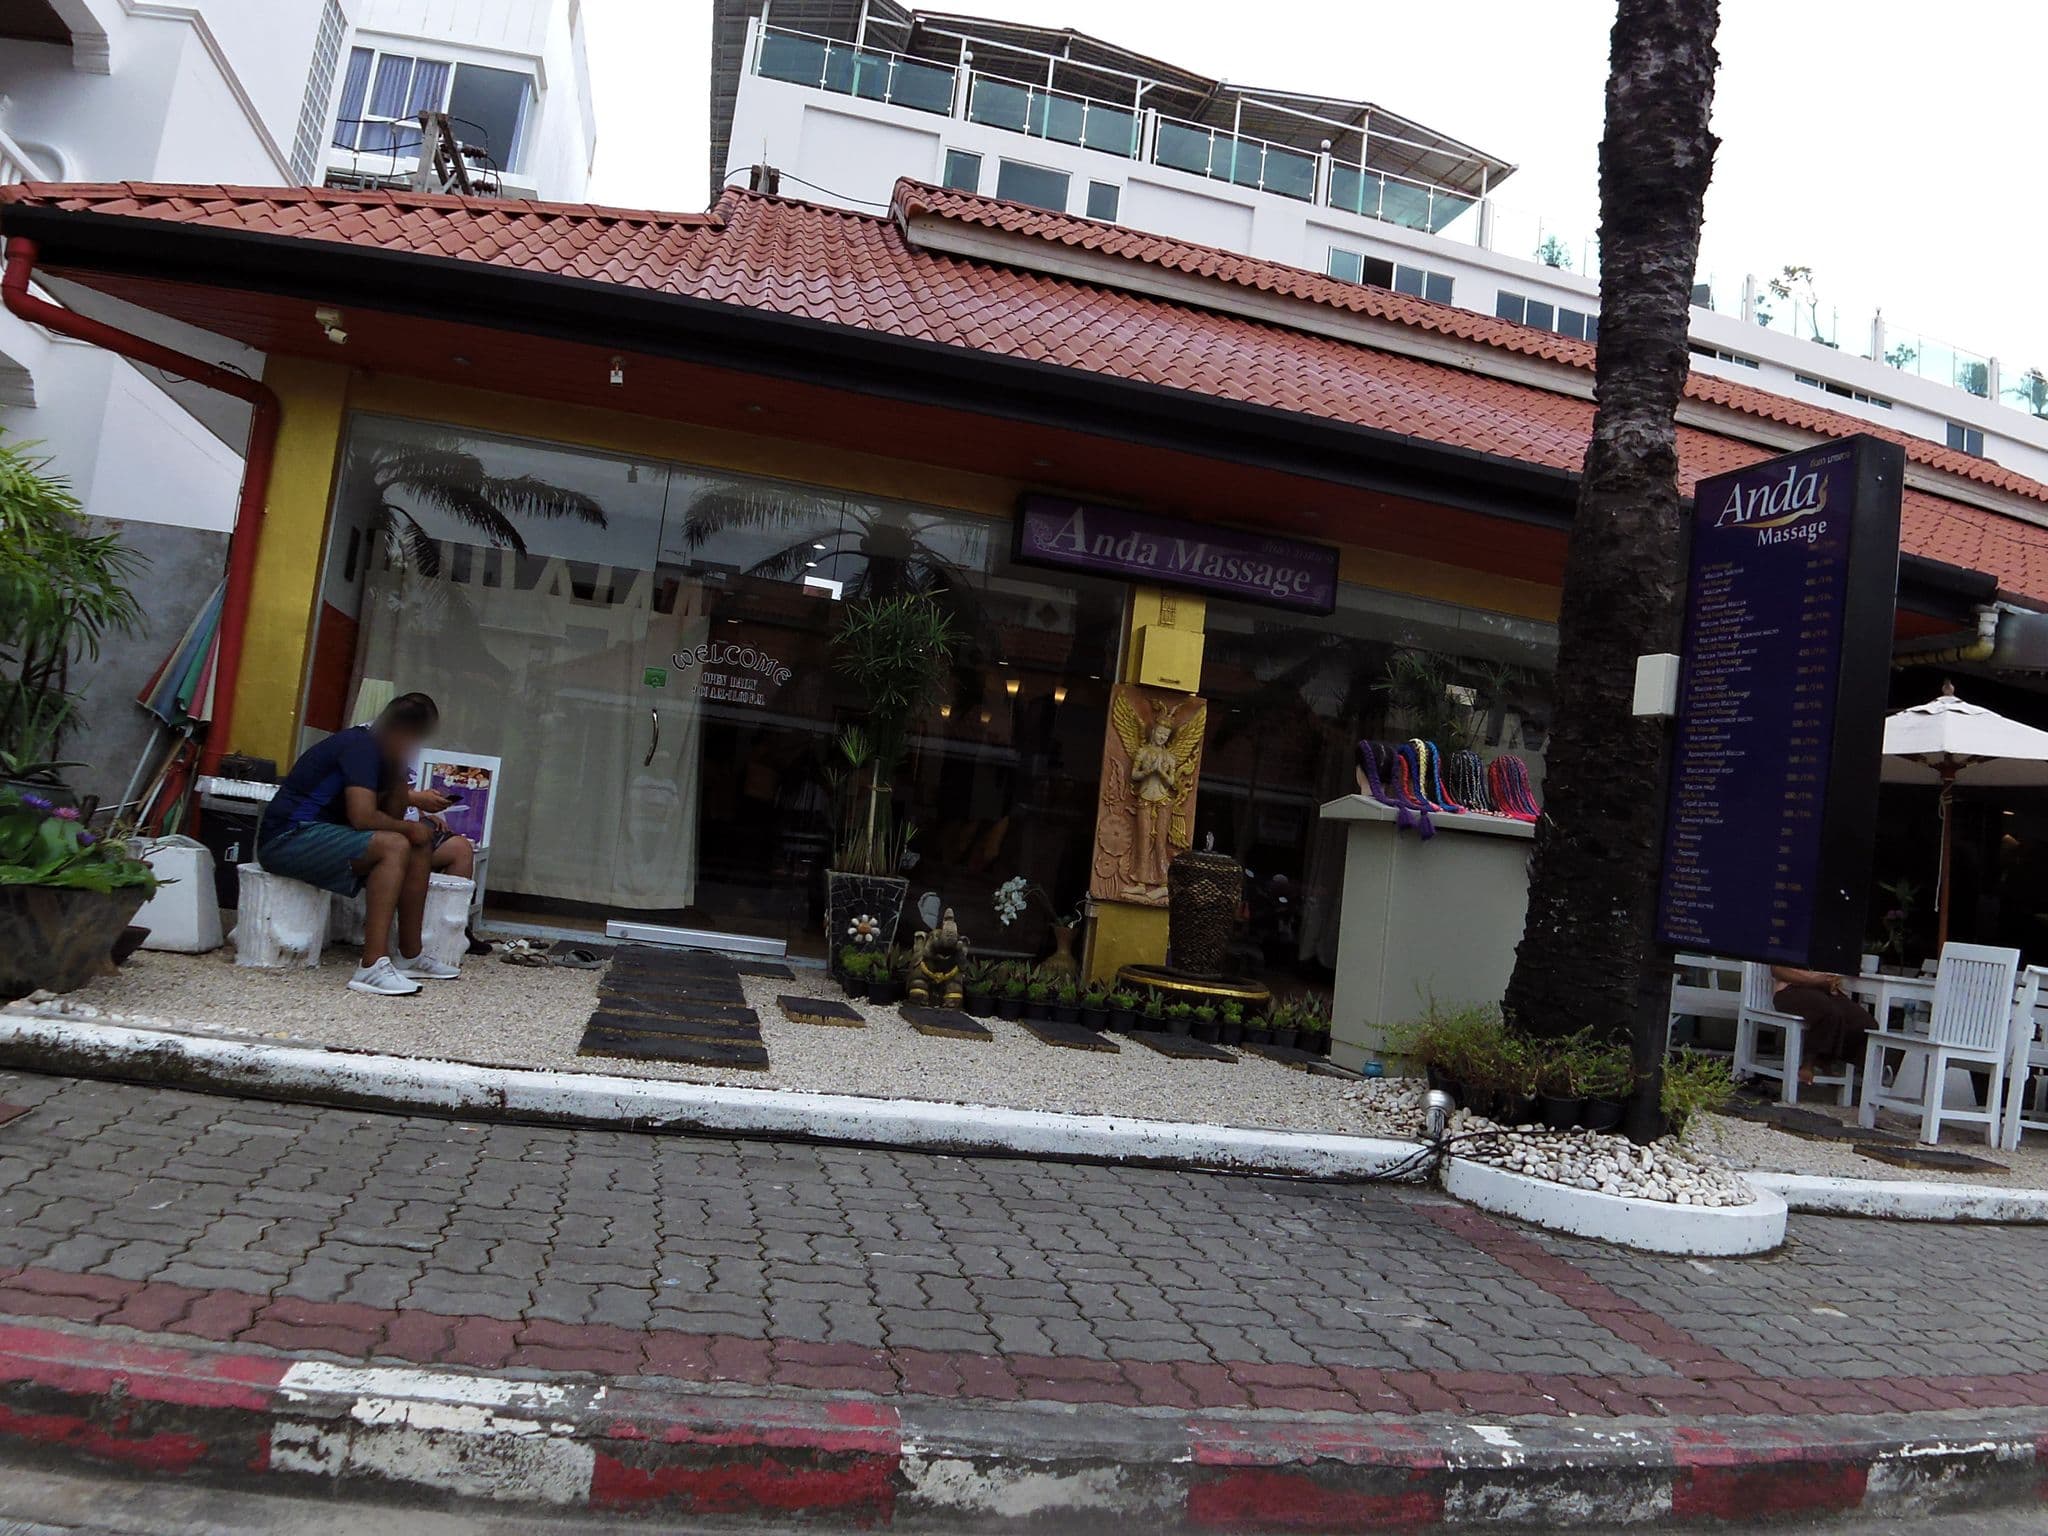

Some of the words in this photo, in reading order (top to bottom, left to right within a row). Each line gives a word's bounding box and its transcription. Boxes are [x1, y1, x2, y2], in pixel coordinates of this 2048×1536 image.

[1714, 466, 1818, 528] Anda
[1049, 505, 1158, 566] Anda
[1168, 538, 1312, 598] Massage
[1757, 520, 1828, 547] Massage
[672, 643, 792, 687] WELCOME
[702, 672, 727, 686] OPEN
